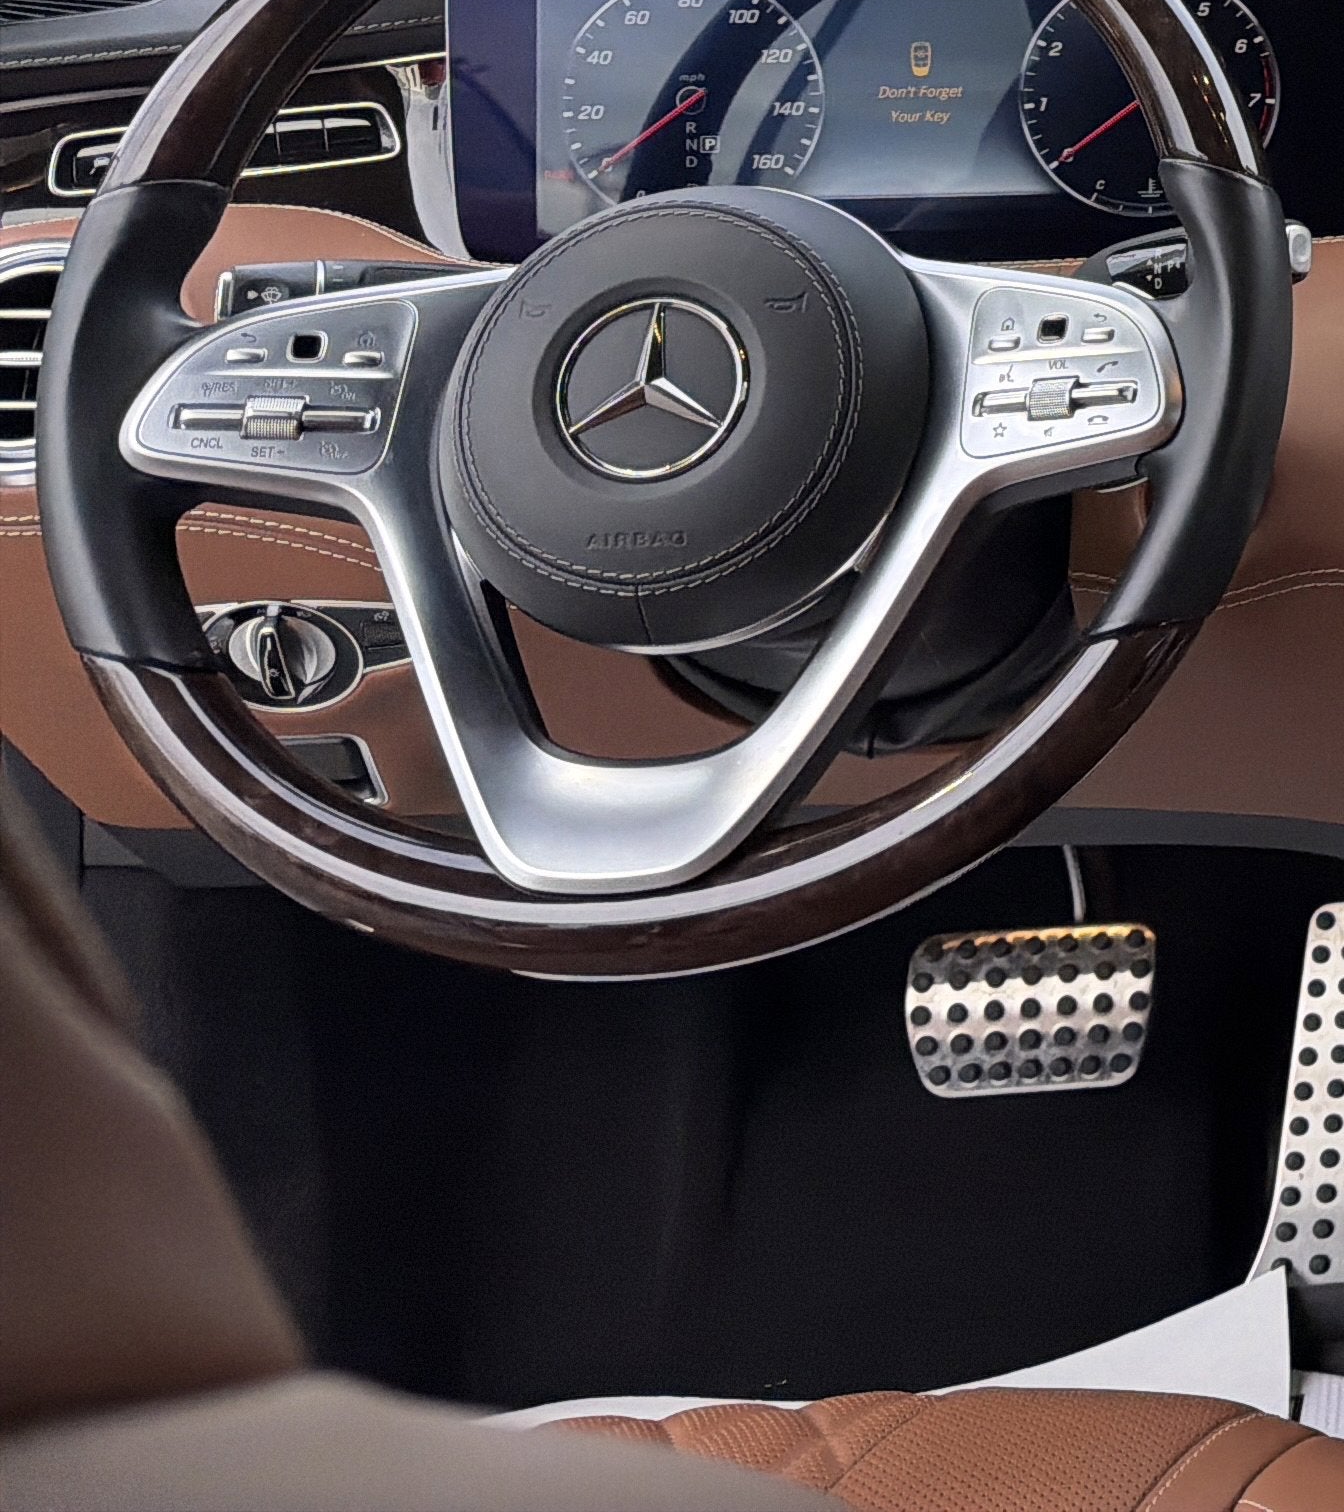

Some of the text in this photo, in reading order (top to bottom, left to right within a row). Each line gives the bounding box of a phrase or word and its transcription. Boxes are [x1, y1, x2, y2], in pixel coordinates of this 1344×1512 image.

[728, 9, 760, 24] 100
[1197, 2, 1211, 17] 5
[623, 10, 650, 25] 60
[1048, 41, 1063, 57] 2
[1233, 38, 1247, 54] 6
[586, 50, 613, 65] 40
[760, 48, 793, 64] 120
[678, 72, 706, 85] mph
[878, 85, 963, 100] Don't Forget
[1247, 92, 1262, 108] 7
[772, 100, 805, 116] 140
[1038, 96, 1048, 112] 1
[577, 105, 605, 120] 20
[890, 110, 951, 125] Your Key
[685, 122, 697, 134] R
[685, 138, 718, 151] N P
[685, 156, 698, 168] D
[751, 154, 784, 170] 160
[1153, 262, 1163, 275] N
[1154, 277, 1163, 290] D
[1048, 358, 1070, 371] VOL
[190, 437, 223, 450] CNCL
